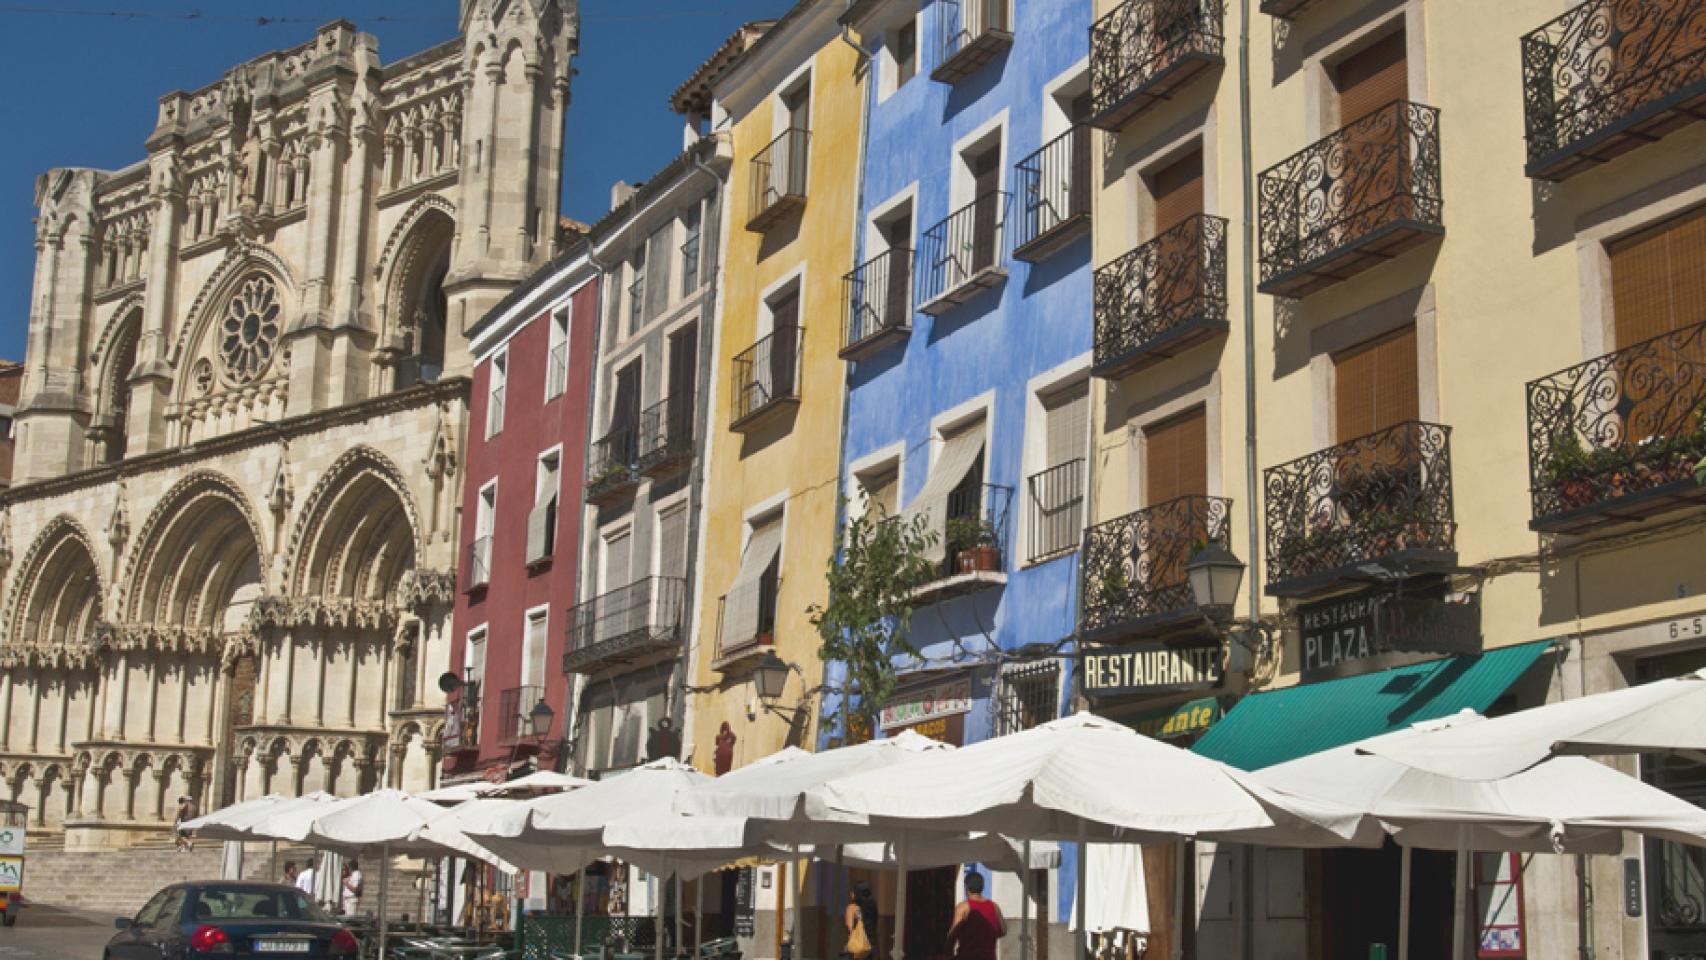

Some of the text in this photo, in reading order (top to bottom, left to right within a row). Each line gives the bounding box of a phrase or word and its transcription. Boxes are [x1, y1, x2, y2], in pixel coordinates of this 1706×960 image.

[1084, 648, 1219, 688] RESTAURANTE
[1304, 625, 1369, 671] PLAZA
[1162, 705, 1212, 734] ante
